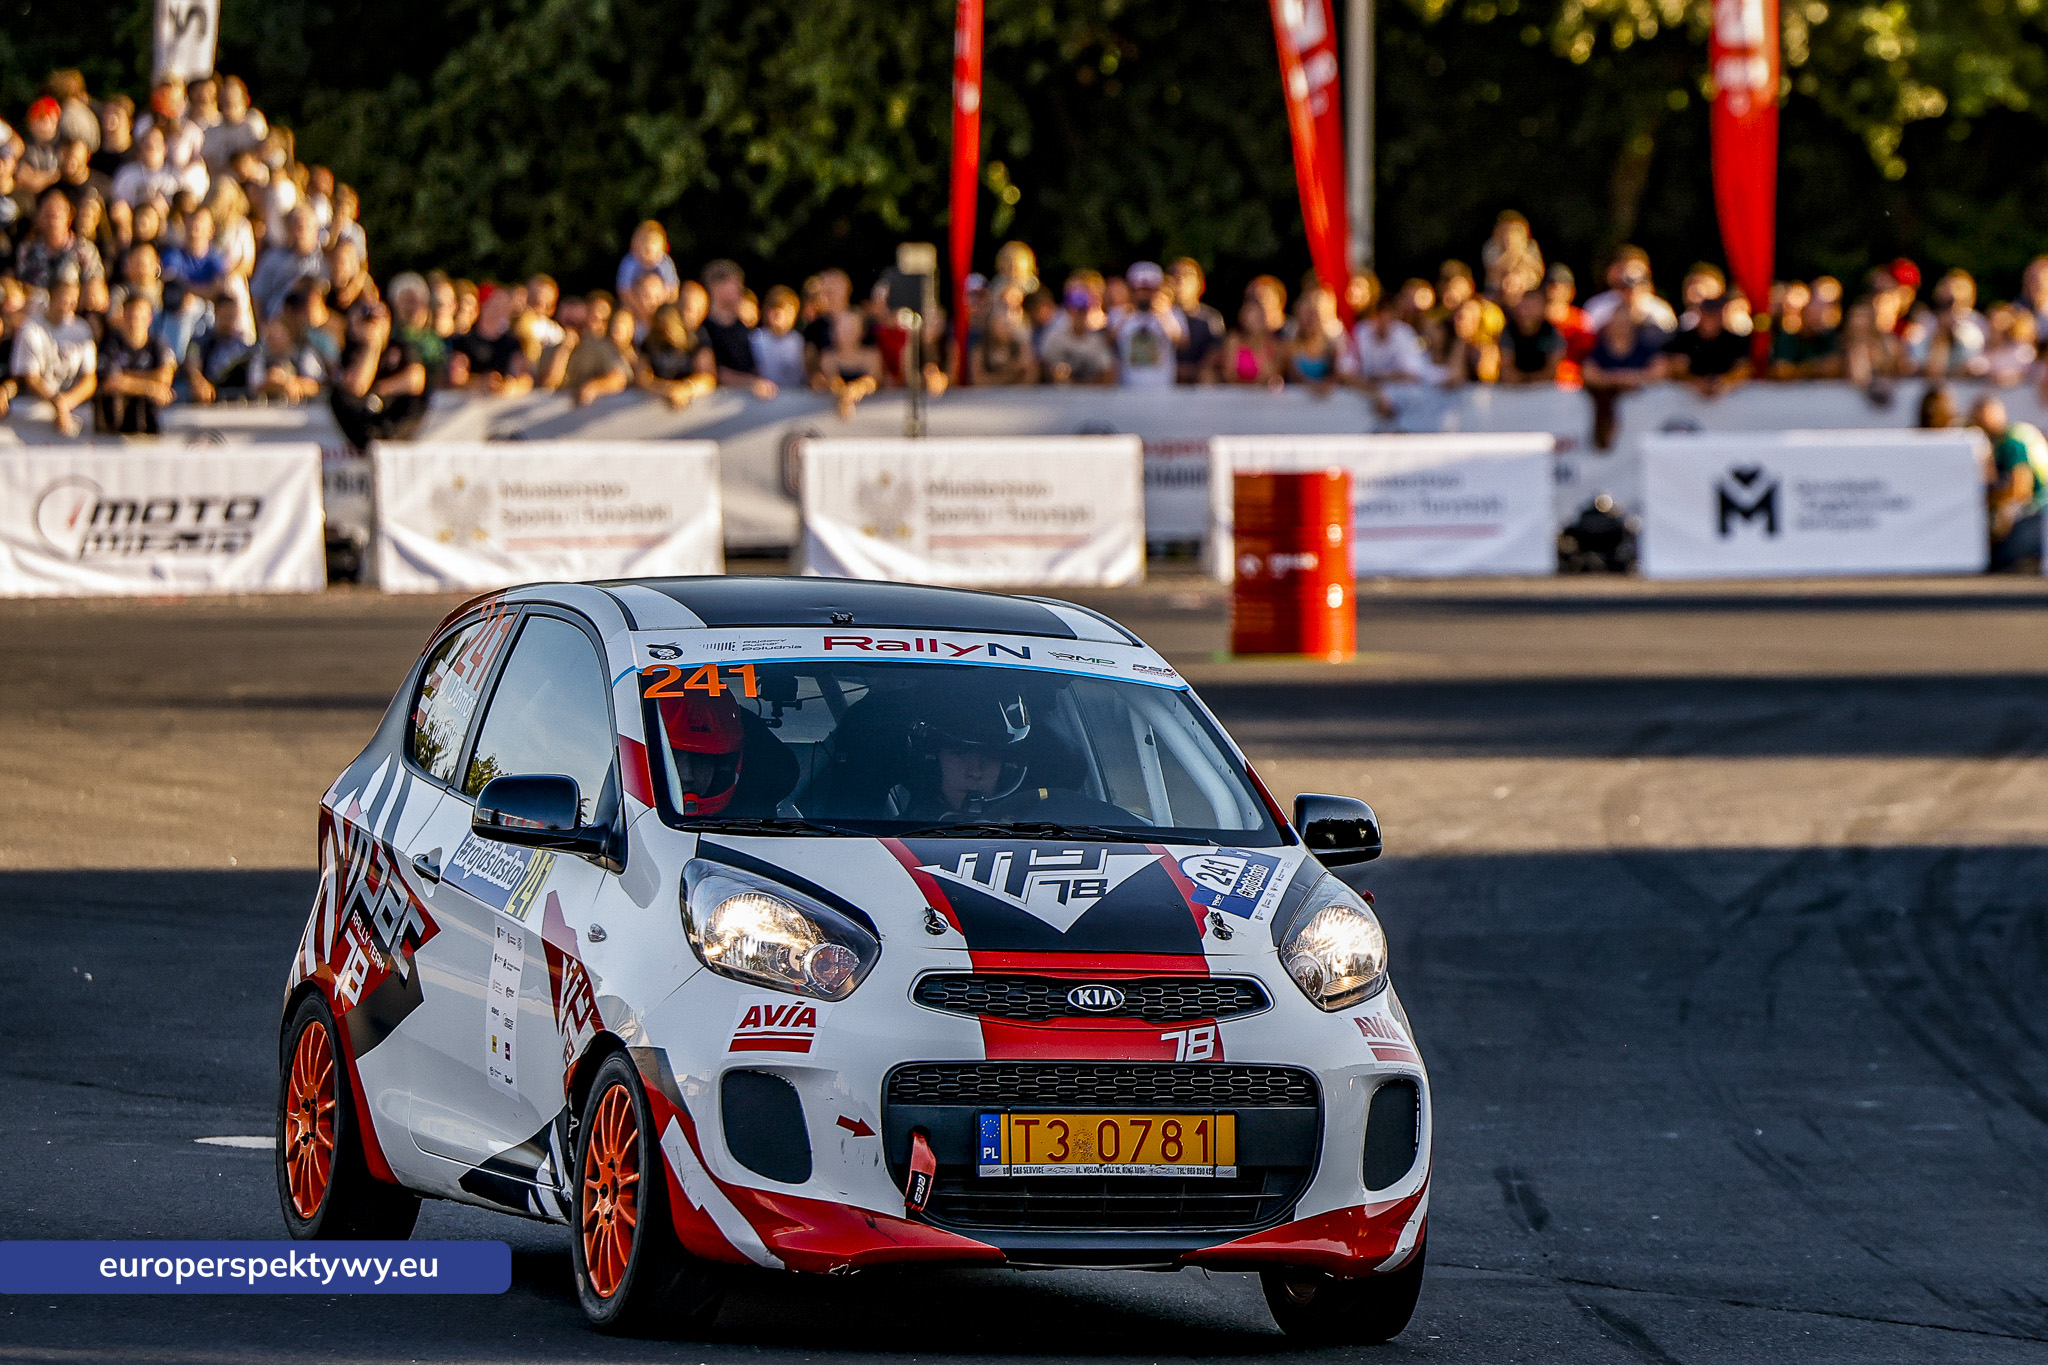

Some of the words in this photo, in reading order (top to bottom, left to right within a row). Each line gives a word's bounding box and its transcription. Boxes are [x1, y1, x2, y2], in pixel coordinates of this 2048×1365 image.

[823, 636, 1031, 660] RallyN
[641, 663, 758, 698] 241
[1195, 859, 1240, 886] 241
[1077, 989, 1118, 1006] KIA
[1160, 1026, 1216, 1062] 78
[983, 1147, 999, 1160] PL
[1014, 1119, 1070, 1163] T3
[1098, 1118, 1210, 1163] 0781
